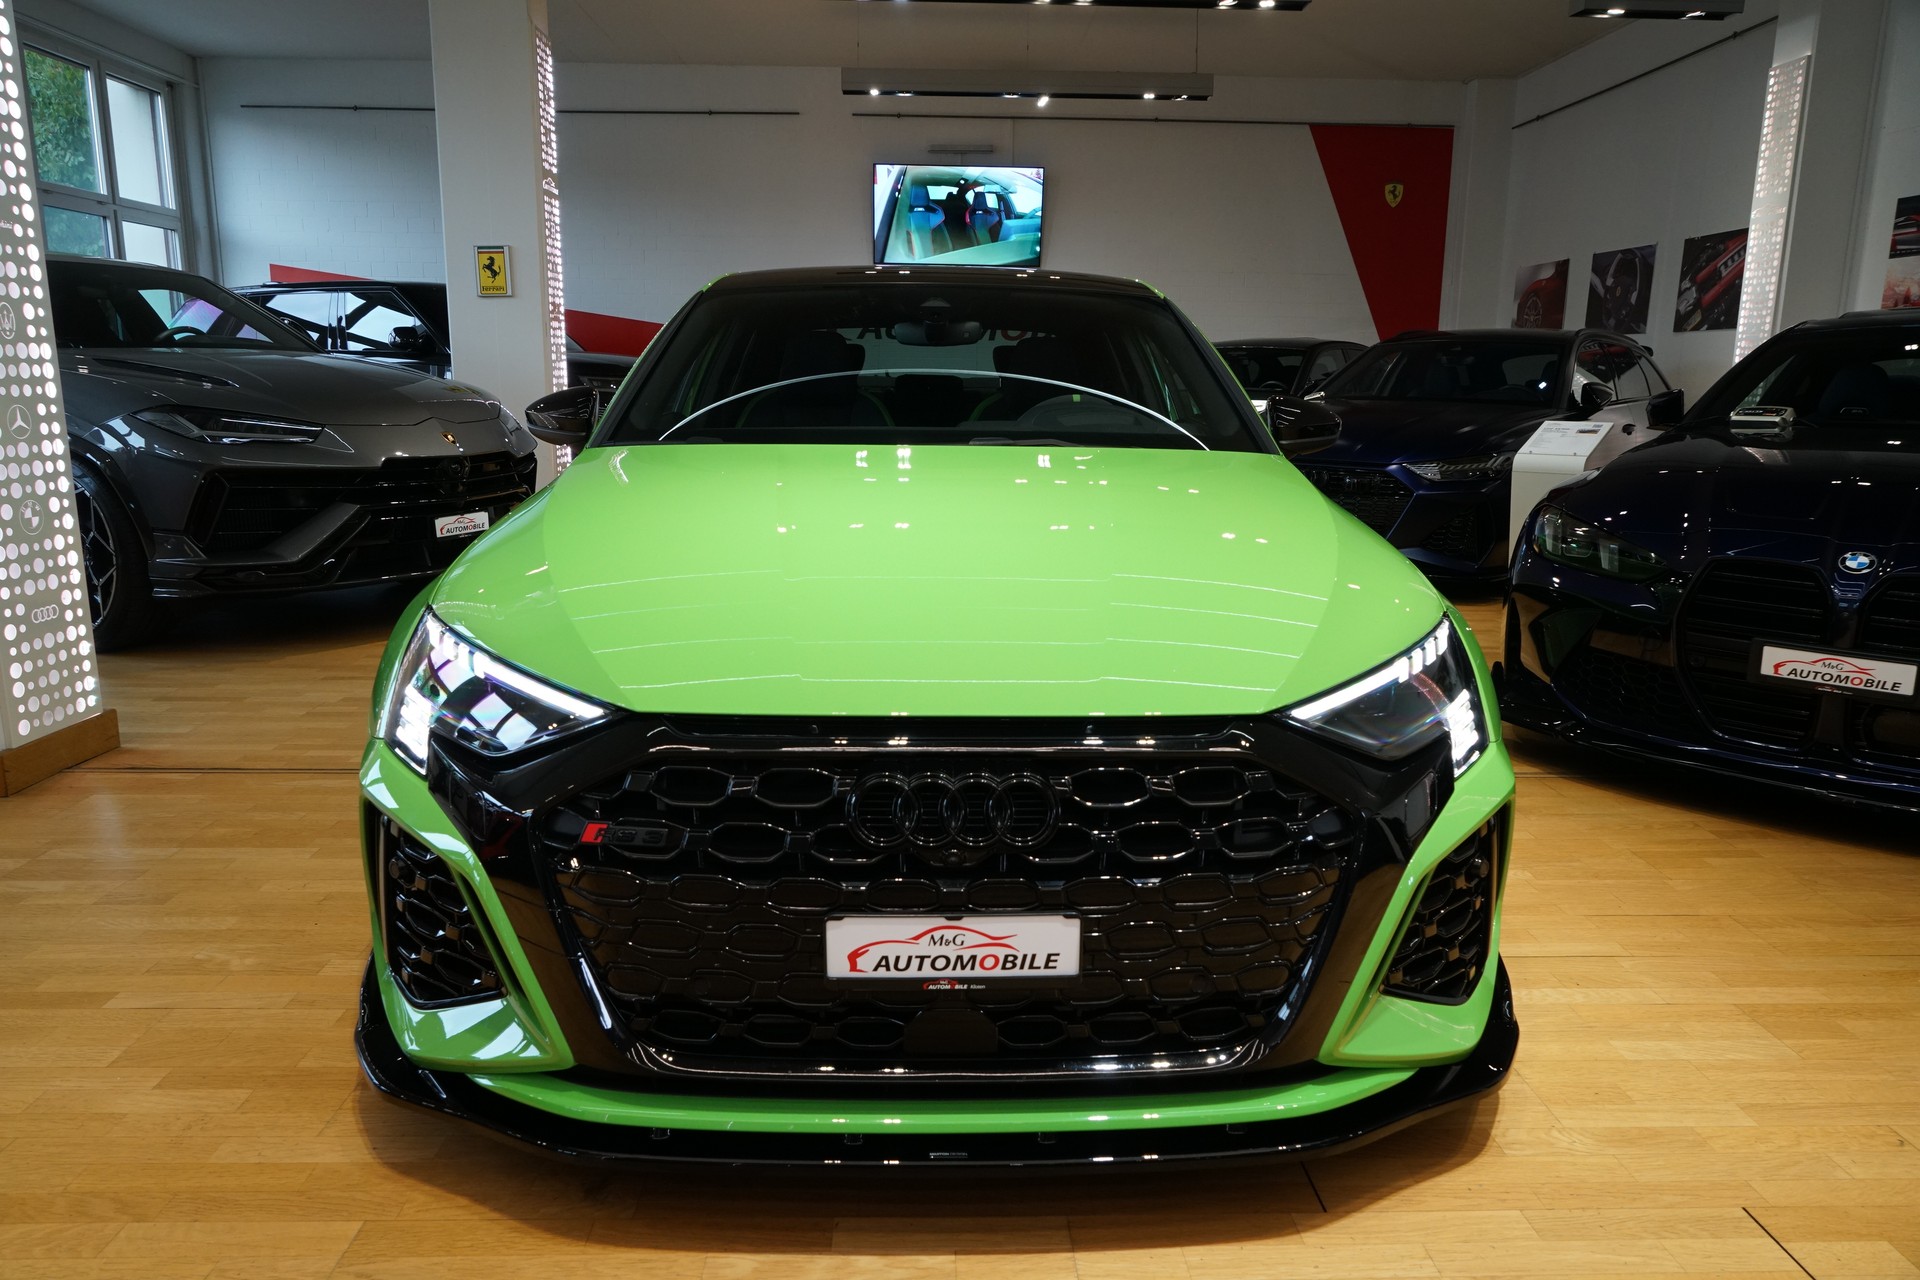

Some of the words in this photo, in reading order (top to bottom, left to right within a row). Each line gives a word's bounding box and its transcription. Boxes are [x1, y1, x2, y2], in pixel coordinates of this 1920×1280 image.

[445, 523, 485, 534] AUTOMOBILE
[1820, 661, 1845, 671] M&G
[1787, 667, 1903, 692] AUTOMOBILE
[928, 933, 966, 947] M&G
[872, 953, 1061, 972] AUTOMOBILE
